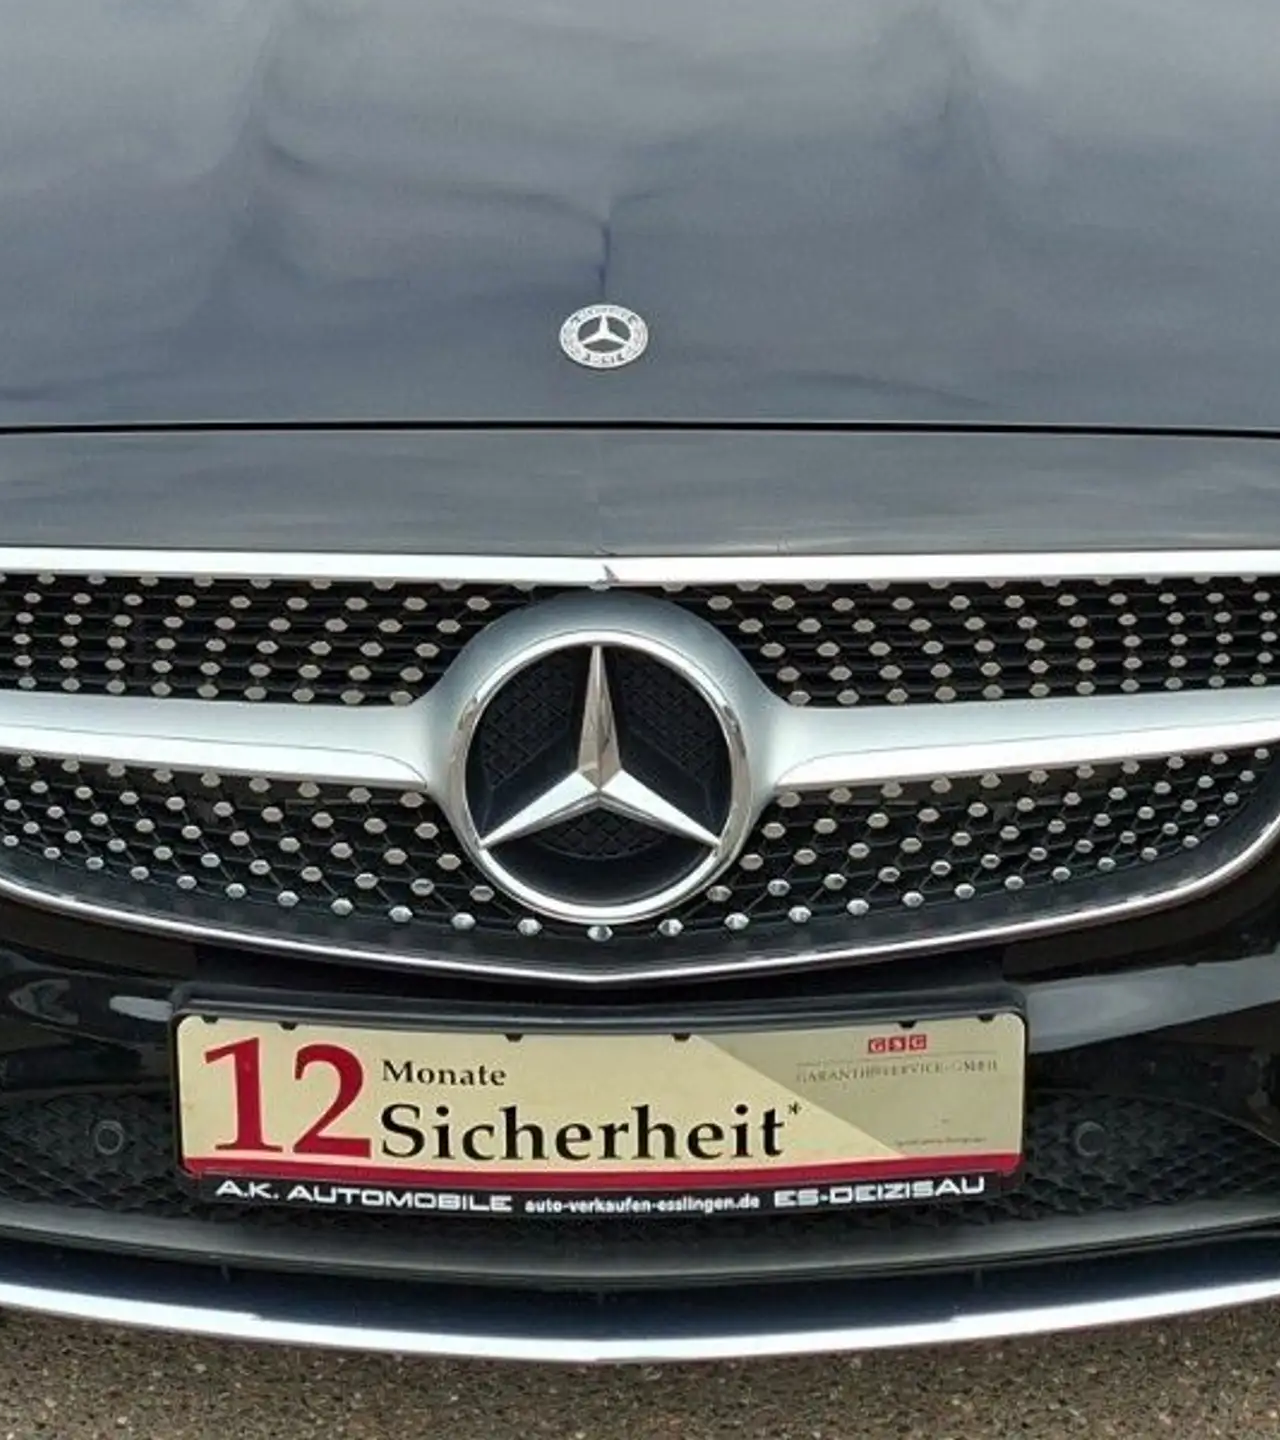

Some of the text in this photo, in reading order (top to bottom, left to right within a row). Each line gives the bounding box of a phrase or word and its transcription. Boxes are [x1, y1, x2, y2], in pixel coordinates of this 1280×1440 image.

[381, 1059, 507, 1087] Monate
[204, 1036, 372, 1159] 12
[215, 1177, 985, 1215] A.K. AUTOMOBILE auto-verkaufen-esslingen.de ES-DEIZISAU
